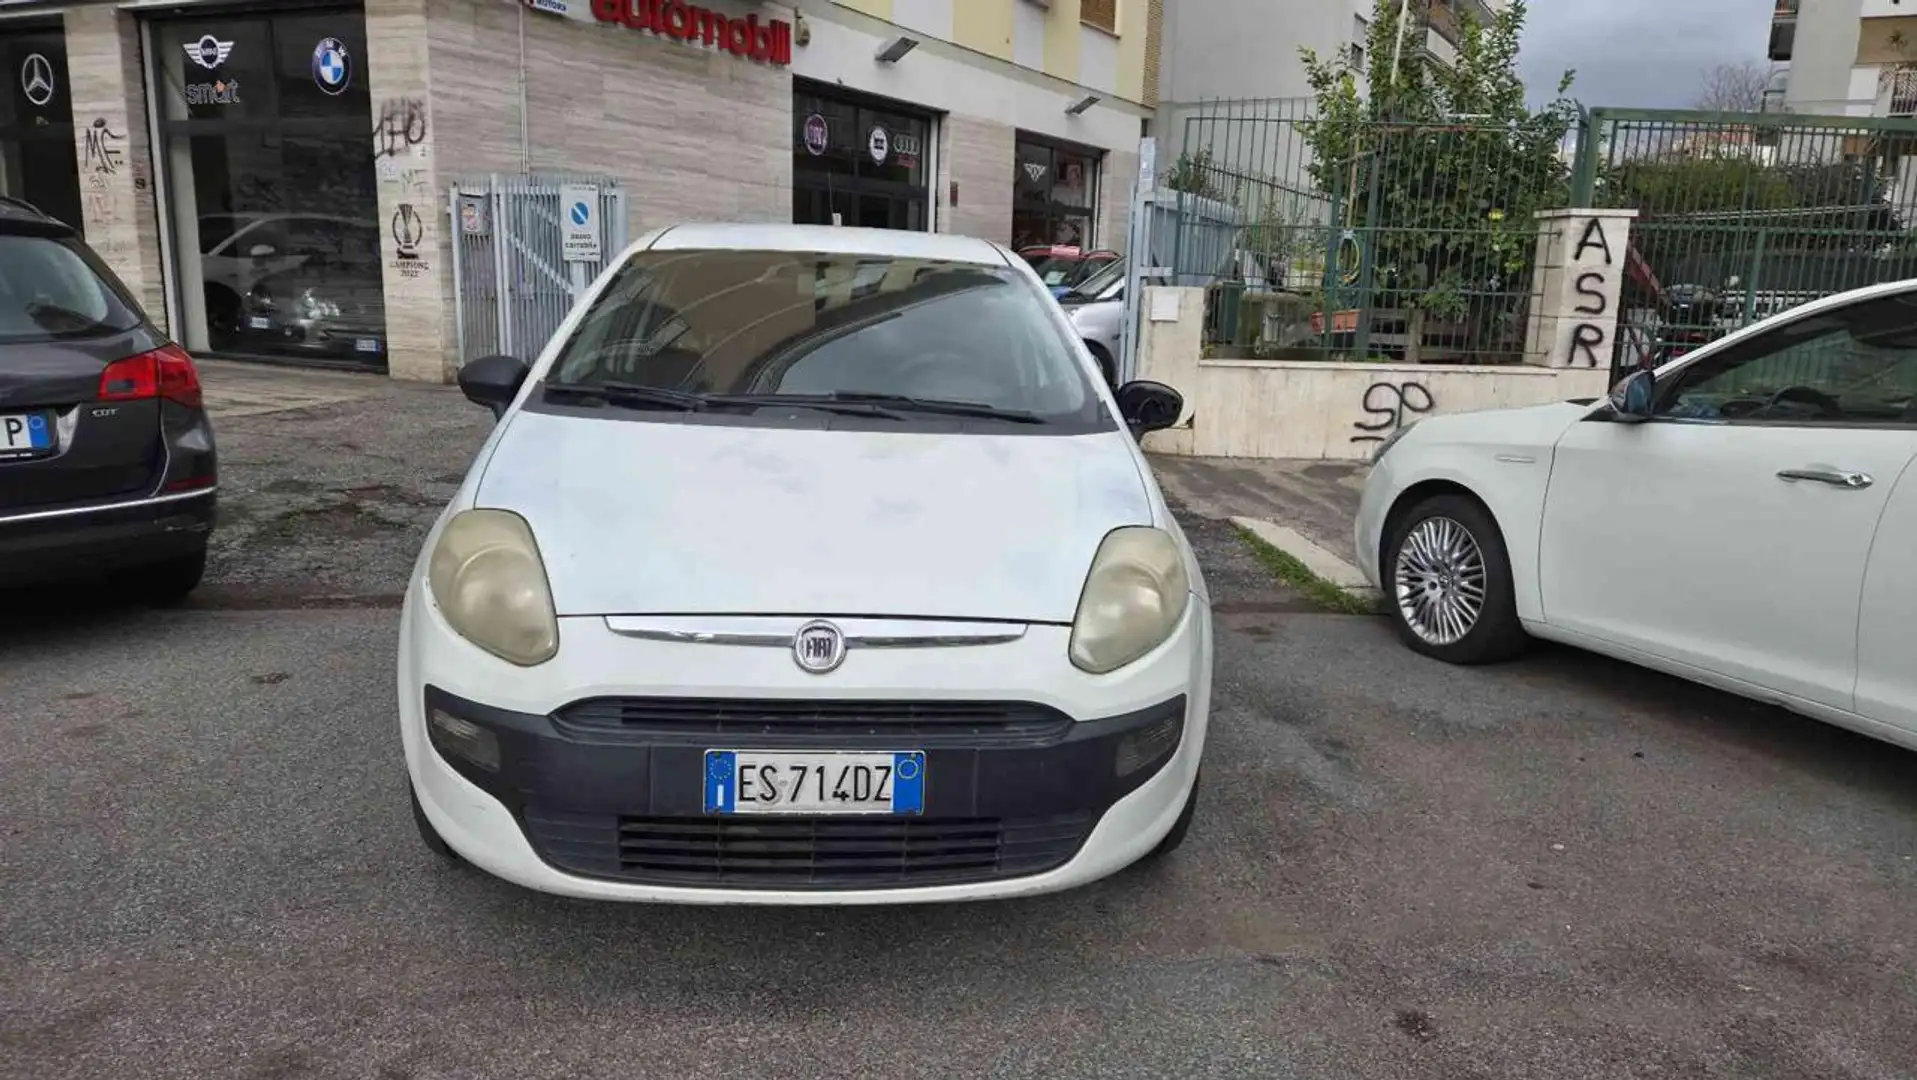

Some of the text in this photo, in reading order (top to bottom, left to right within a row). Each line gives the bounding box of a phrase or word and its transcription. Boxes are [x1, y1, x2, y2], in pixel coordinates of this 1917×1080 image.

[590, 0, 792, 65] automobili
[1568, 217, 1612, 368] ASR
[805, 637, 832, 659] FIAT
